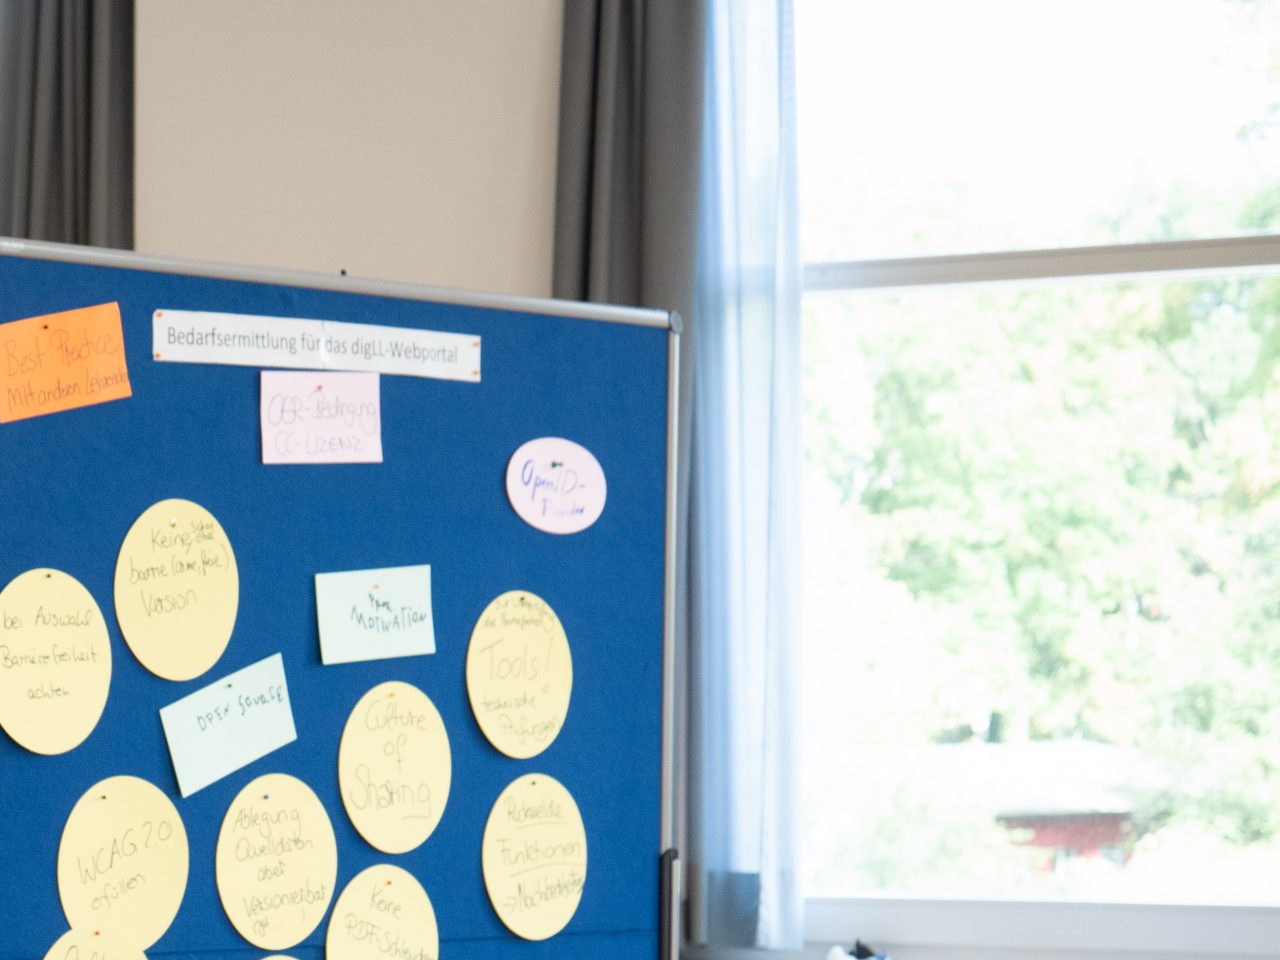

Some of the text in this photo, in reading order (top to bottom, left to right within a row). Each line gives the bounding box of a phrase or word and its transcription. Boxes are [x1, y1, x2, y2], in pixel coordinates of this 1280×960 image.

[167, 325, 297, 355] Bedarfsermittlung
[301, 331, 321, 352] für
[325, 335, 348, 354] das
[383, 733, 408, 773] of
